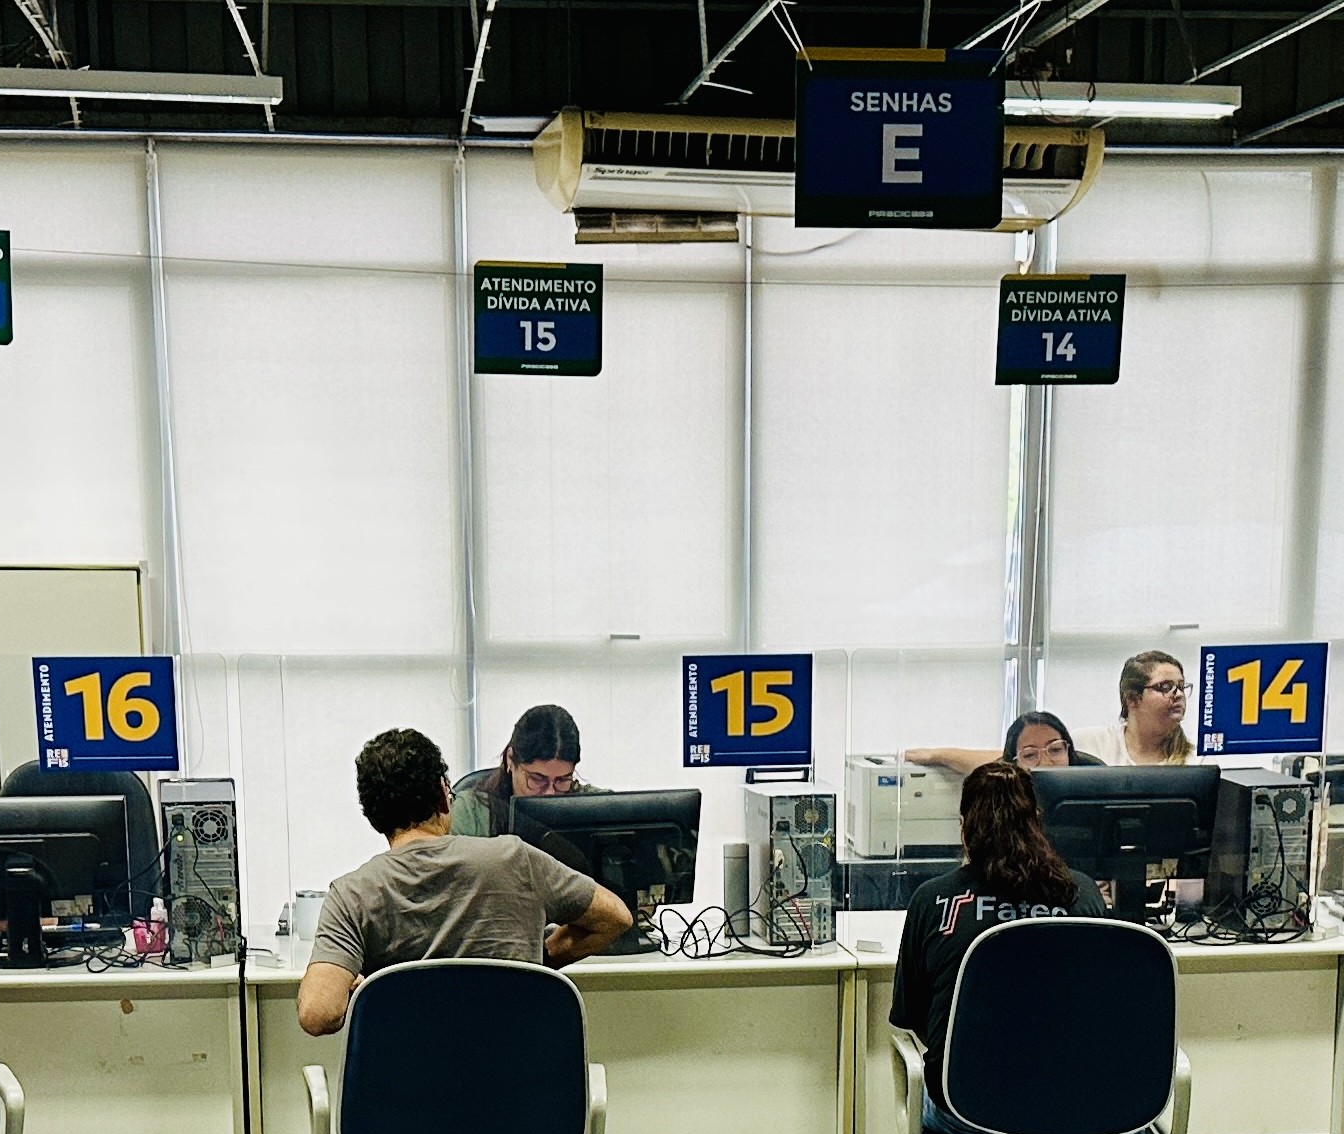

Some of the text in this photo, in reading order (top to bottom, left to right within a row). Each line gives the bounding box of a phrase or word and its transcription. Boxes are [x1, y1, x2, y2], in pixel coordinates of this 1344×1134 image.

[850, 92, 952, 113] SENHAS
[882, 123, 923, 184] E
[480, 278, 596, 294] ATENDIMENTO
[487, 293, 591, 312] DÍVIDA ATIVA
[1006, 291, 1118, 304] ATENDIMENTO
[520, 320, 556, 351] 15
[1011, 306, 1111, 322] DÍVIDA ATIVA
[1042, 332, 1076, 361] 14
[39, 665, 54, 742] ATENDIMENTO
[64, 671, 160, 742] 16
[688, 663, 698, 738] ATENDIMENTO
[710, 670, 794, 736] 15
[1204, 653, 1215, 727] ATENDIMENTO
[1227, 659, 1308, 725] 14
